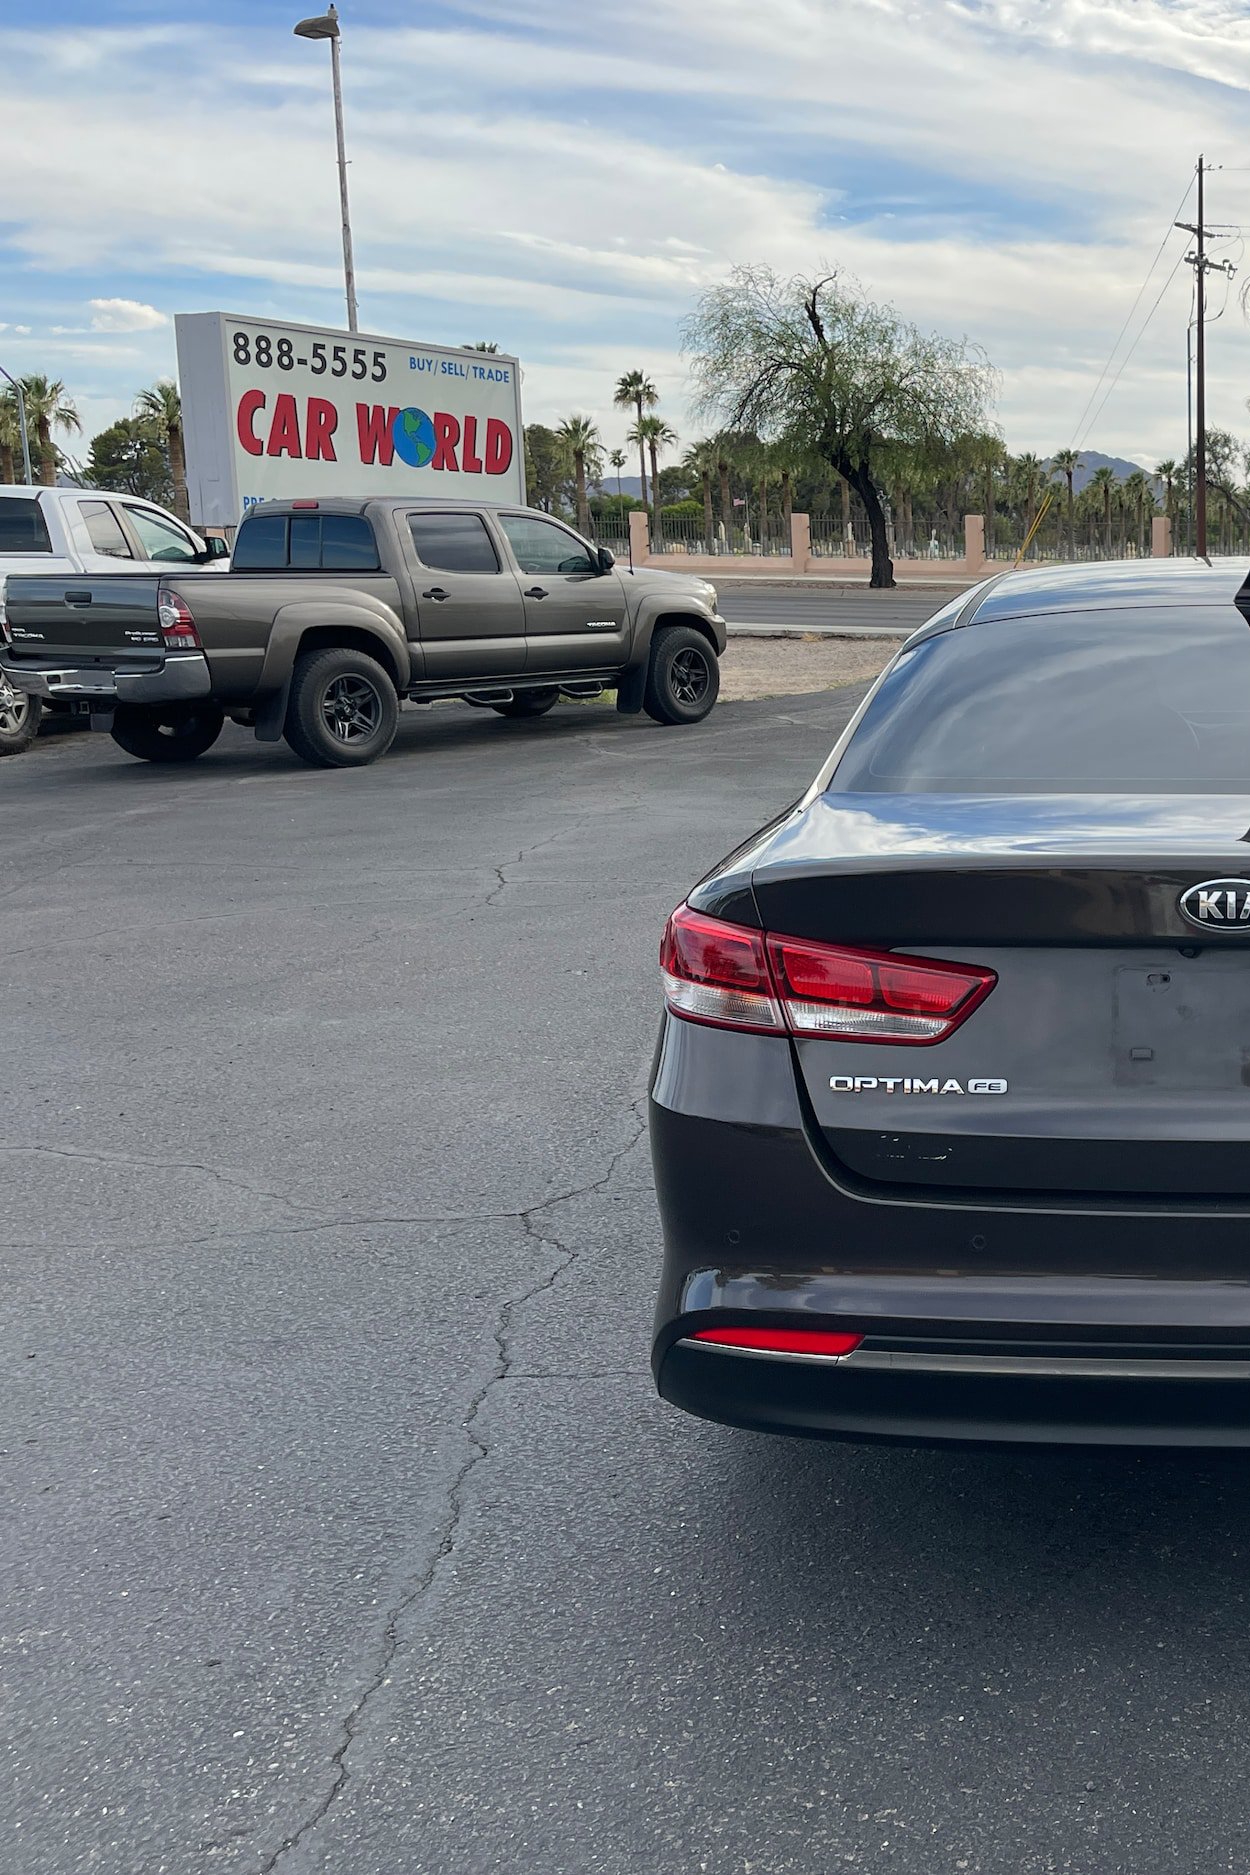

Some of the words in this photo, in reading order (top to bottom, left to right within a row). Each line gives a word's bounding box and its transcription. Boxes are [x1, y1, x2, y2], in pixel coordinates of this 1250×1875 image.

[233, 332, 387, 382] 888-5555
[237, 389, 338, 462] CAR
[355, 402, 513, 475] WORLD
[828, 1075, 966, 1095] OPTIMA
[972, 1080, 1004, 1092] FE
